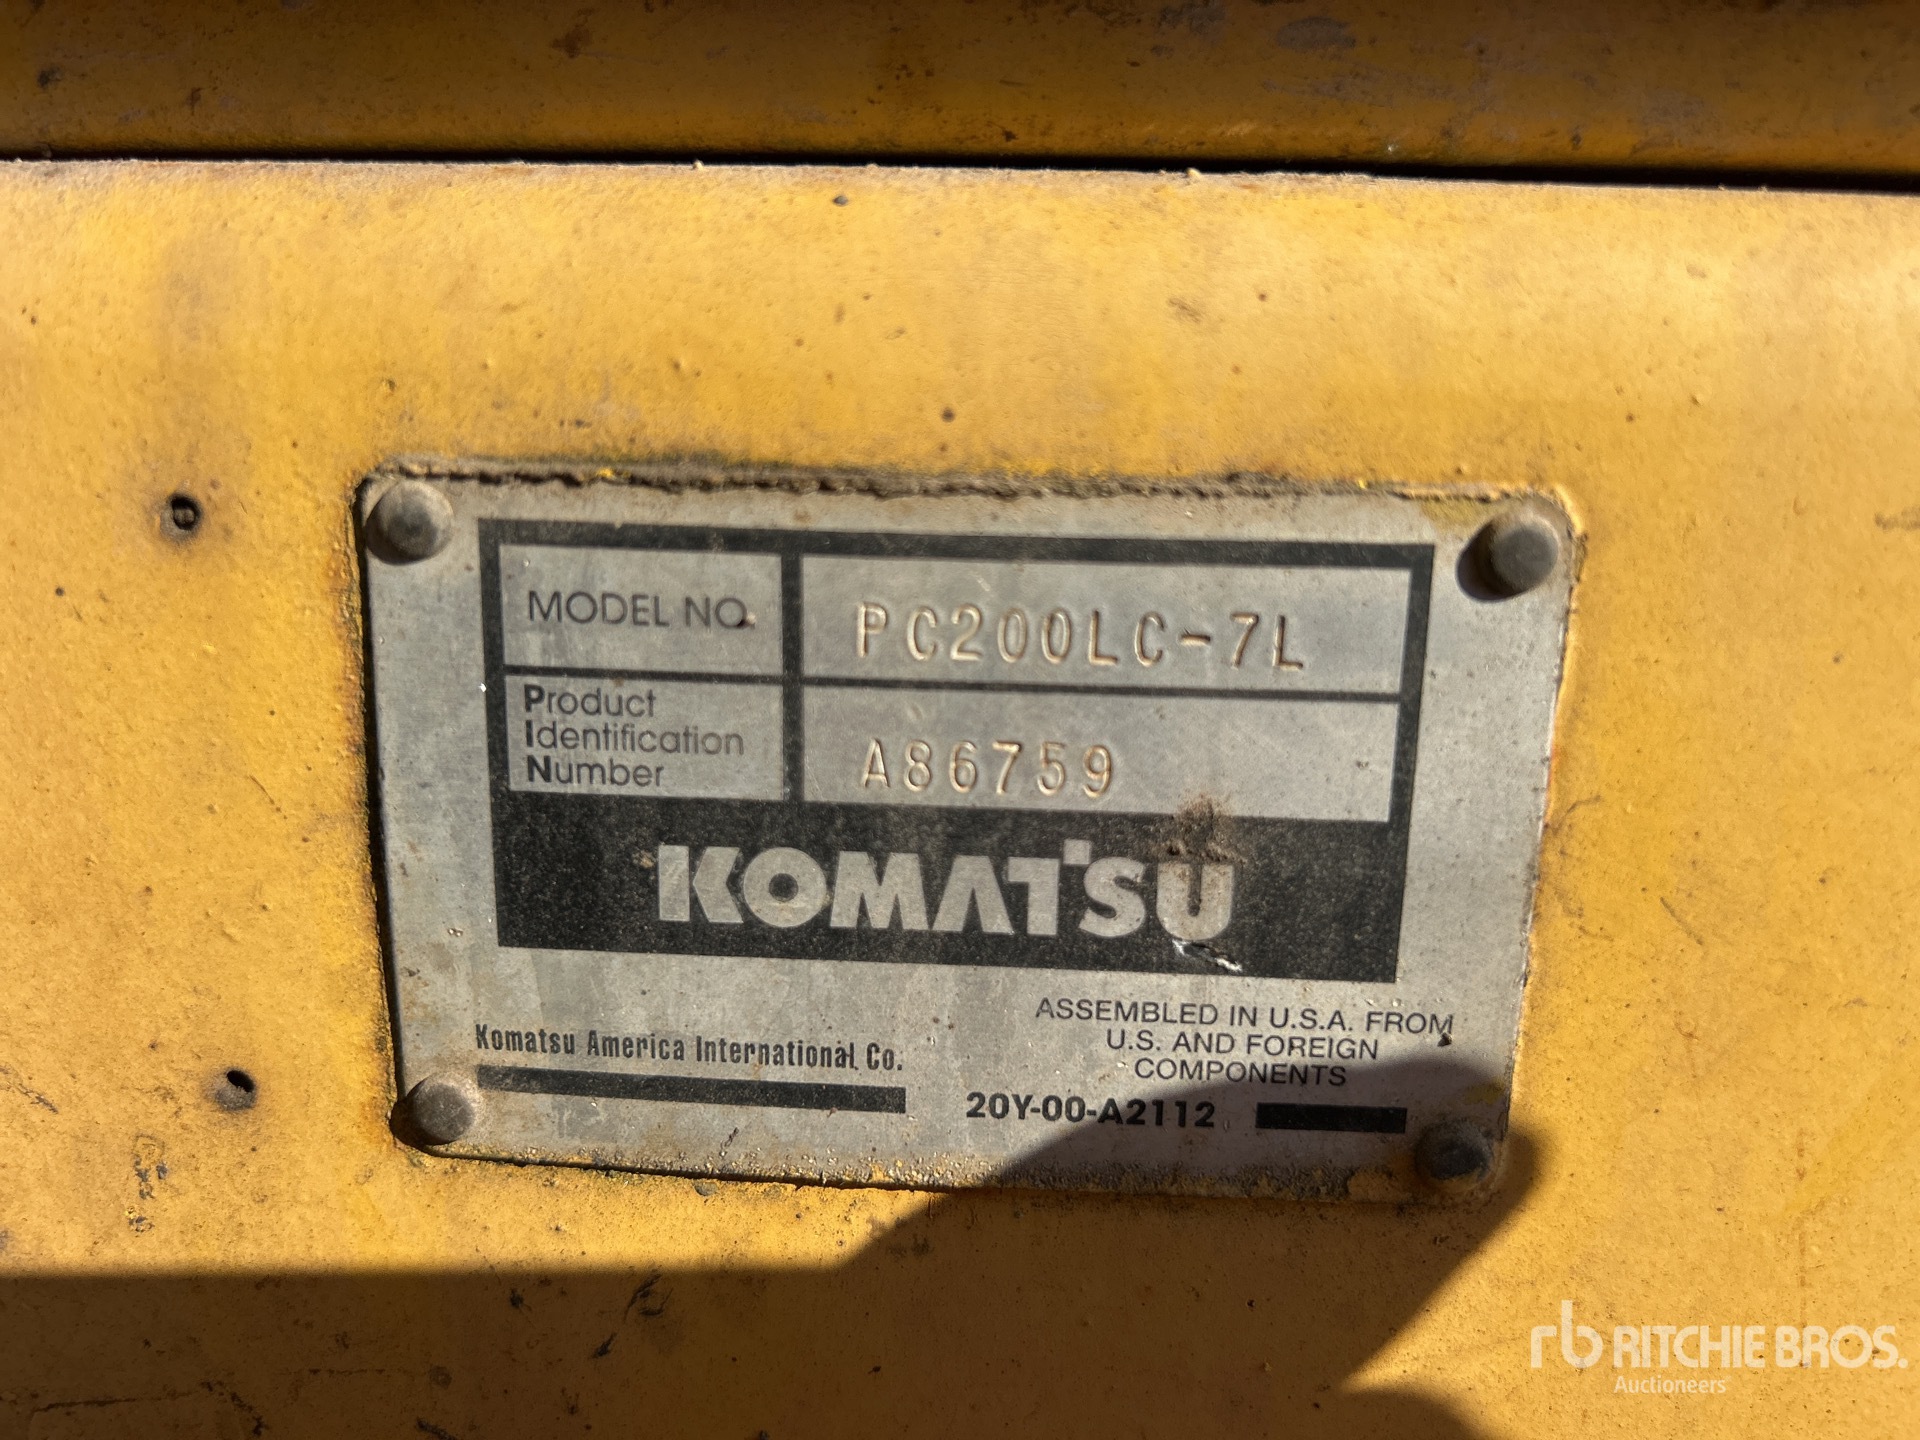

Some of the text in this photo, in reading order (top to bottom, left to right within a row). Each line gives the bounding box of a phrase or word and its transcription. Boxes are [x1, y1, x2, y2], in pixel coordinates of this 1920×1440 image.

[528, 590, 670, 628] MODEL
[855, 602, 1305, 670] PC200LC-7L
[524, 683, 657, 718] Product
[525, 719, 745, 756] Identification
[527, 754, 665, 787] Number
[861, 738, 1113, 799] A86759
[657, 838, 1236, 942] KOMATSU
[1035, 997, 1454, 1036] ASSEMBLED IN U.S.A. FROM
[475, 1023, 904, 1072] Komatsu America International Co.
[1106, 1030, 1379, 1061] U.S. AND FOREIGN
[1134, 1058, 1348, 1087] COMPONENTS
[965, 1091, 1216, 1128] 20Y-00-A2112
